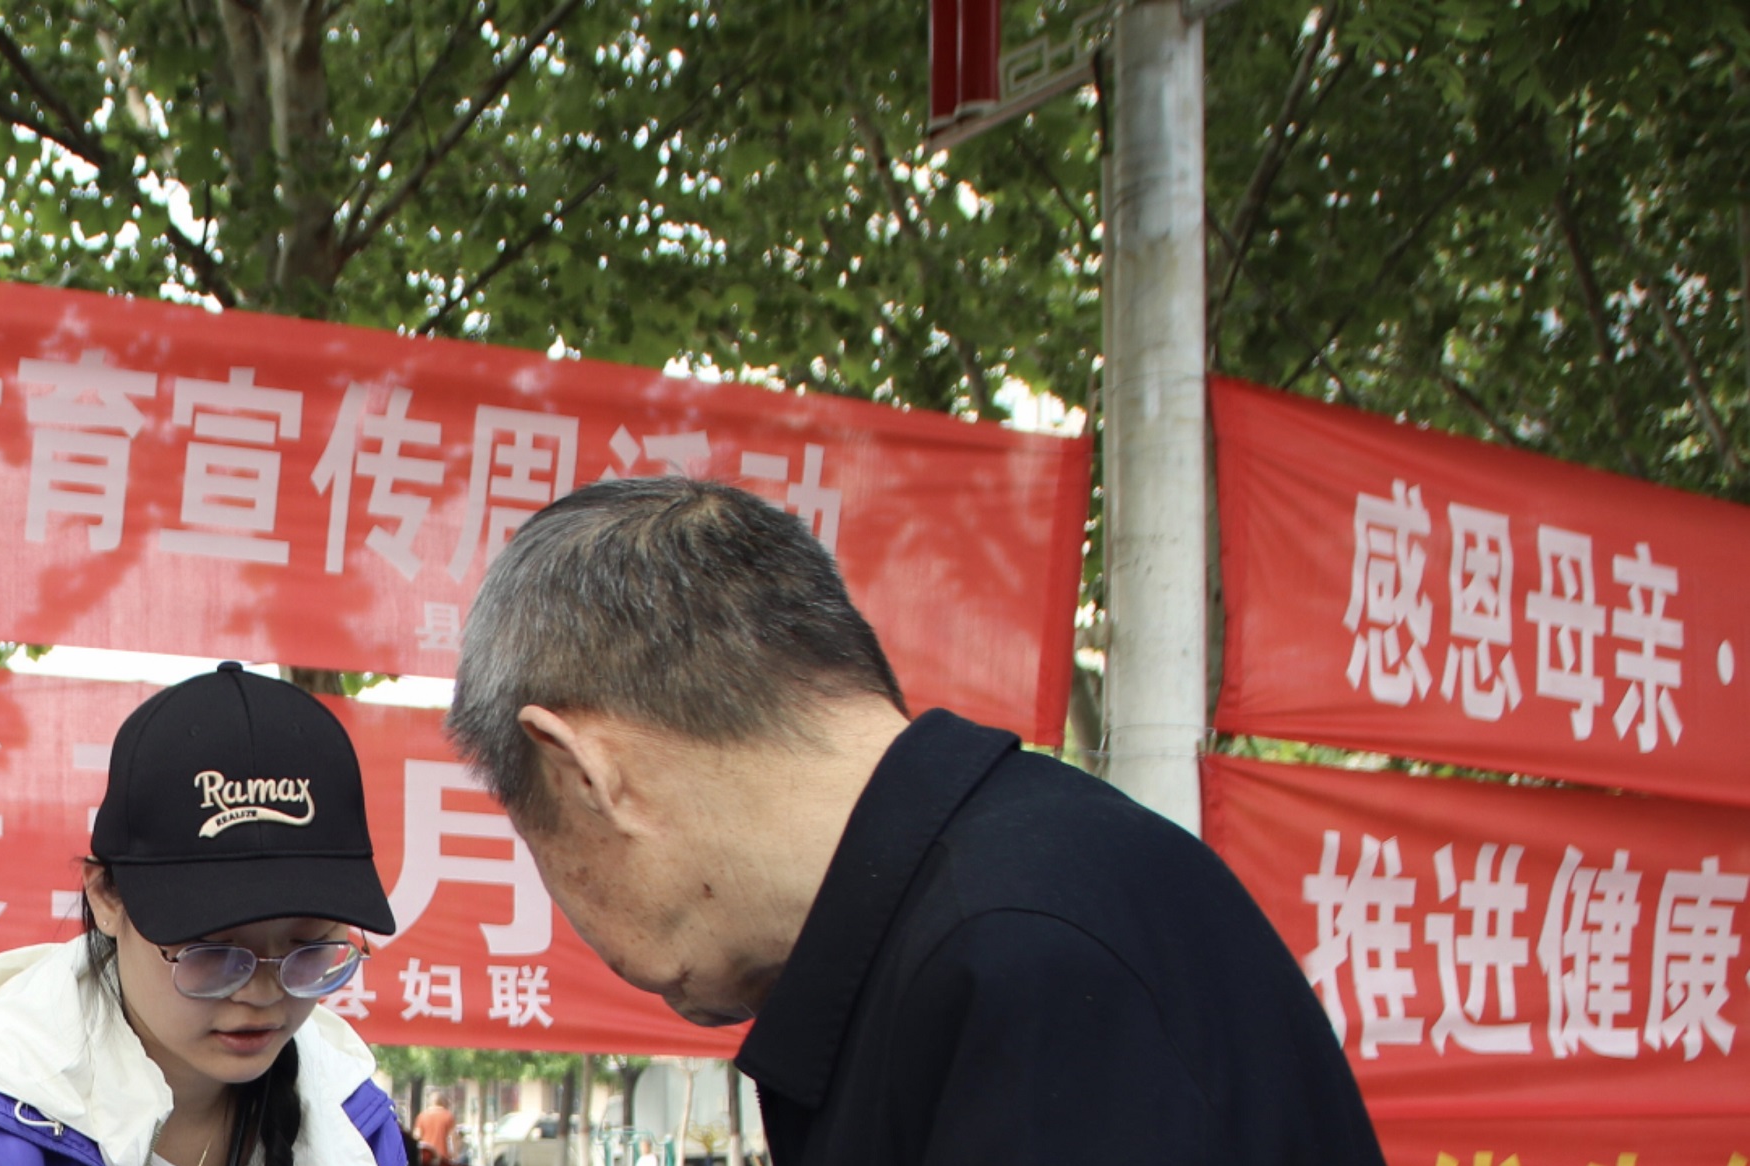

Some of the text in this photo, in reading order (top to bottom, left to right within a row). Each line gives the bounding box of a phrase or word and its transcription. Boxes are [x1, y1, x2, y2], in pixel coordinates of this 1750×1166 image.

[194, 770, 312, 809] Ramax
[1302, 830, 1750, 1061] 推进健康
